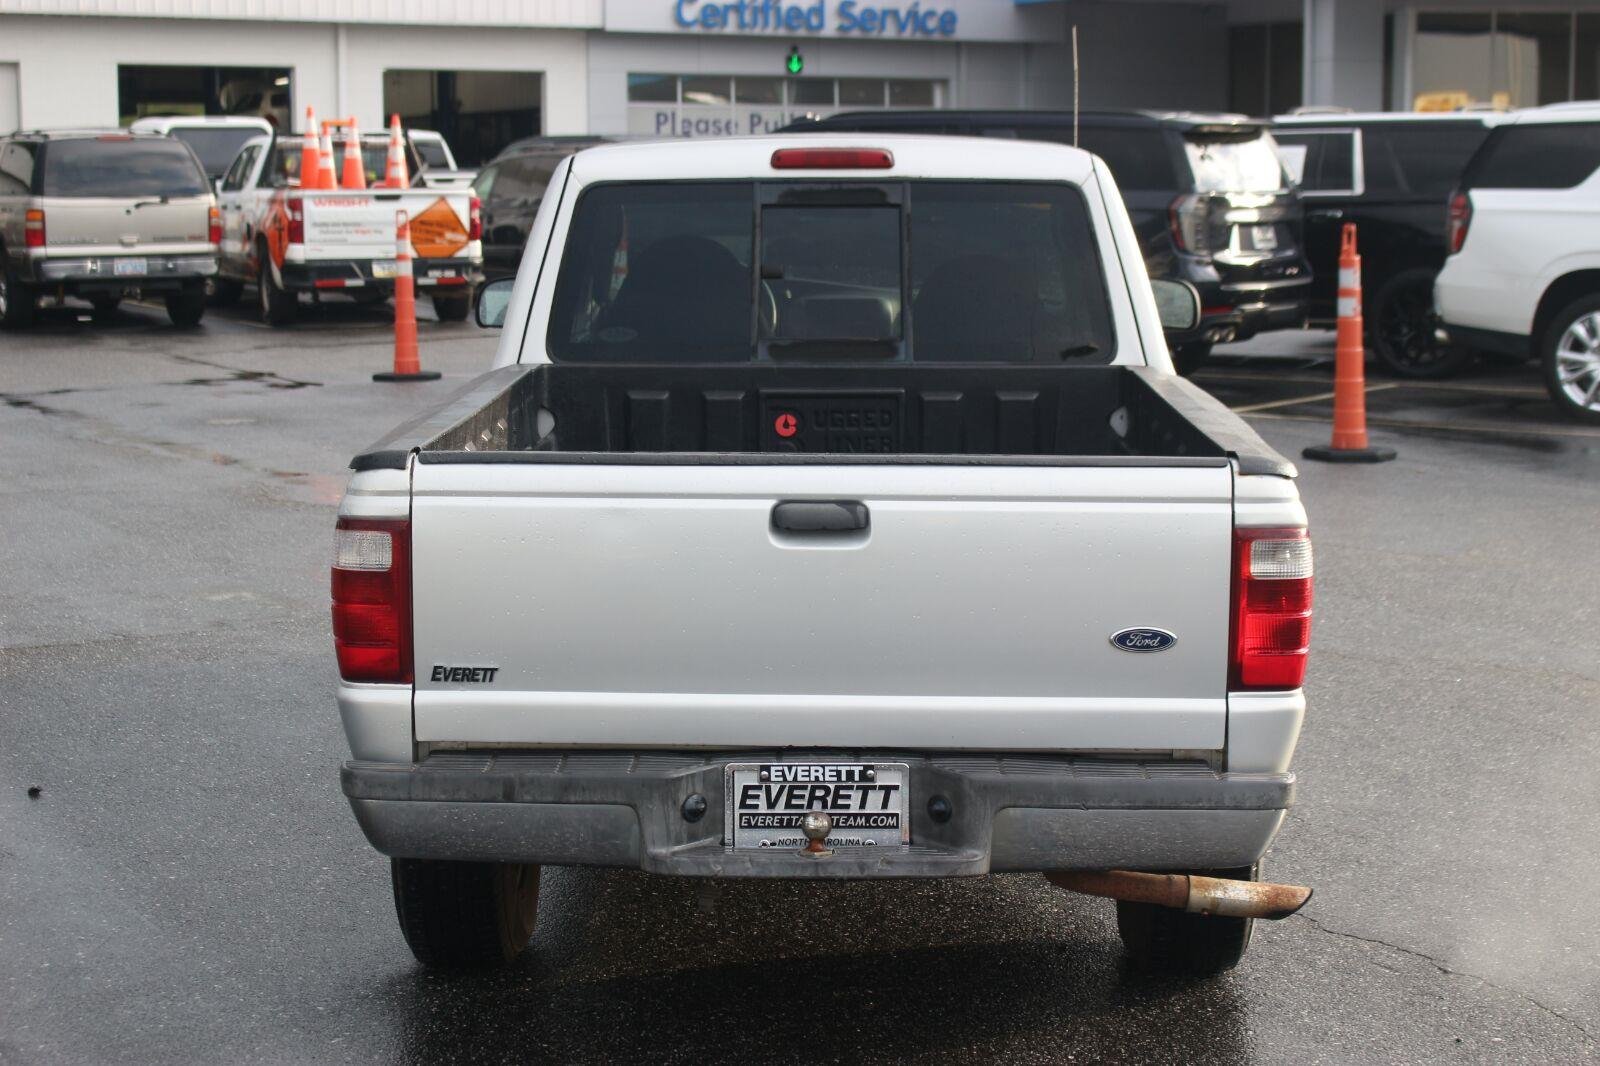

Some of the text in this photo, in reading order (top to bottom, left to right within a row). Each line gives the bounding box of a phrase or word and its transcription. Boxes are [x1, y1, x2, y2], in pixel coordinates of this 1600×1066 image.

[674, 0, 957, 35] Certified Service
[655, 111, 738, 137] Please
[1126, 632, 1161, 646] Ford
[430, 665, 499, 683] EVERETT
[770, 766, 864, 782] EVERETT
[738, 784, 900, 810] EVERETT
[741, 815, 897, 827] EVERETTATEAM.COM
